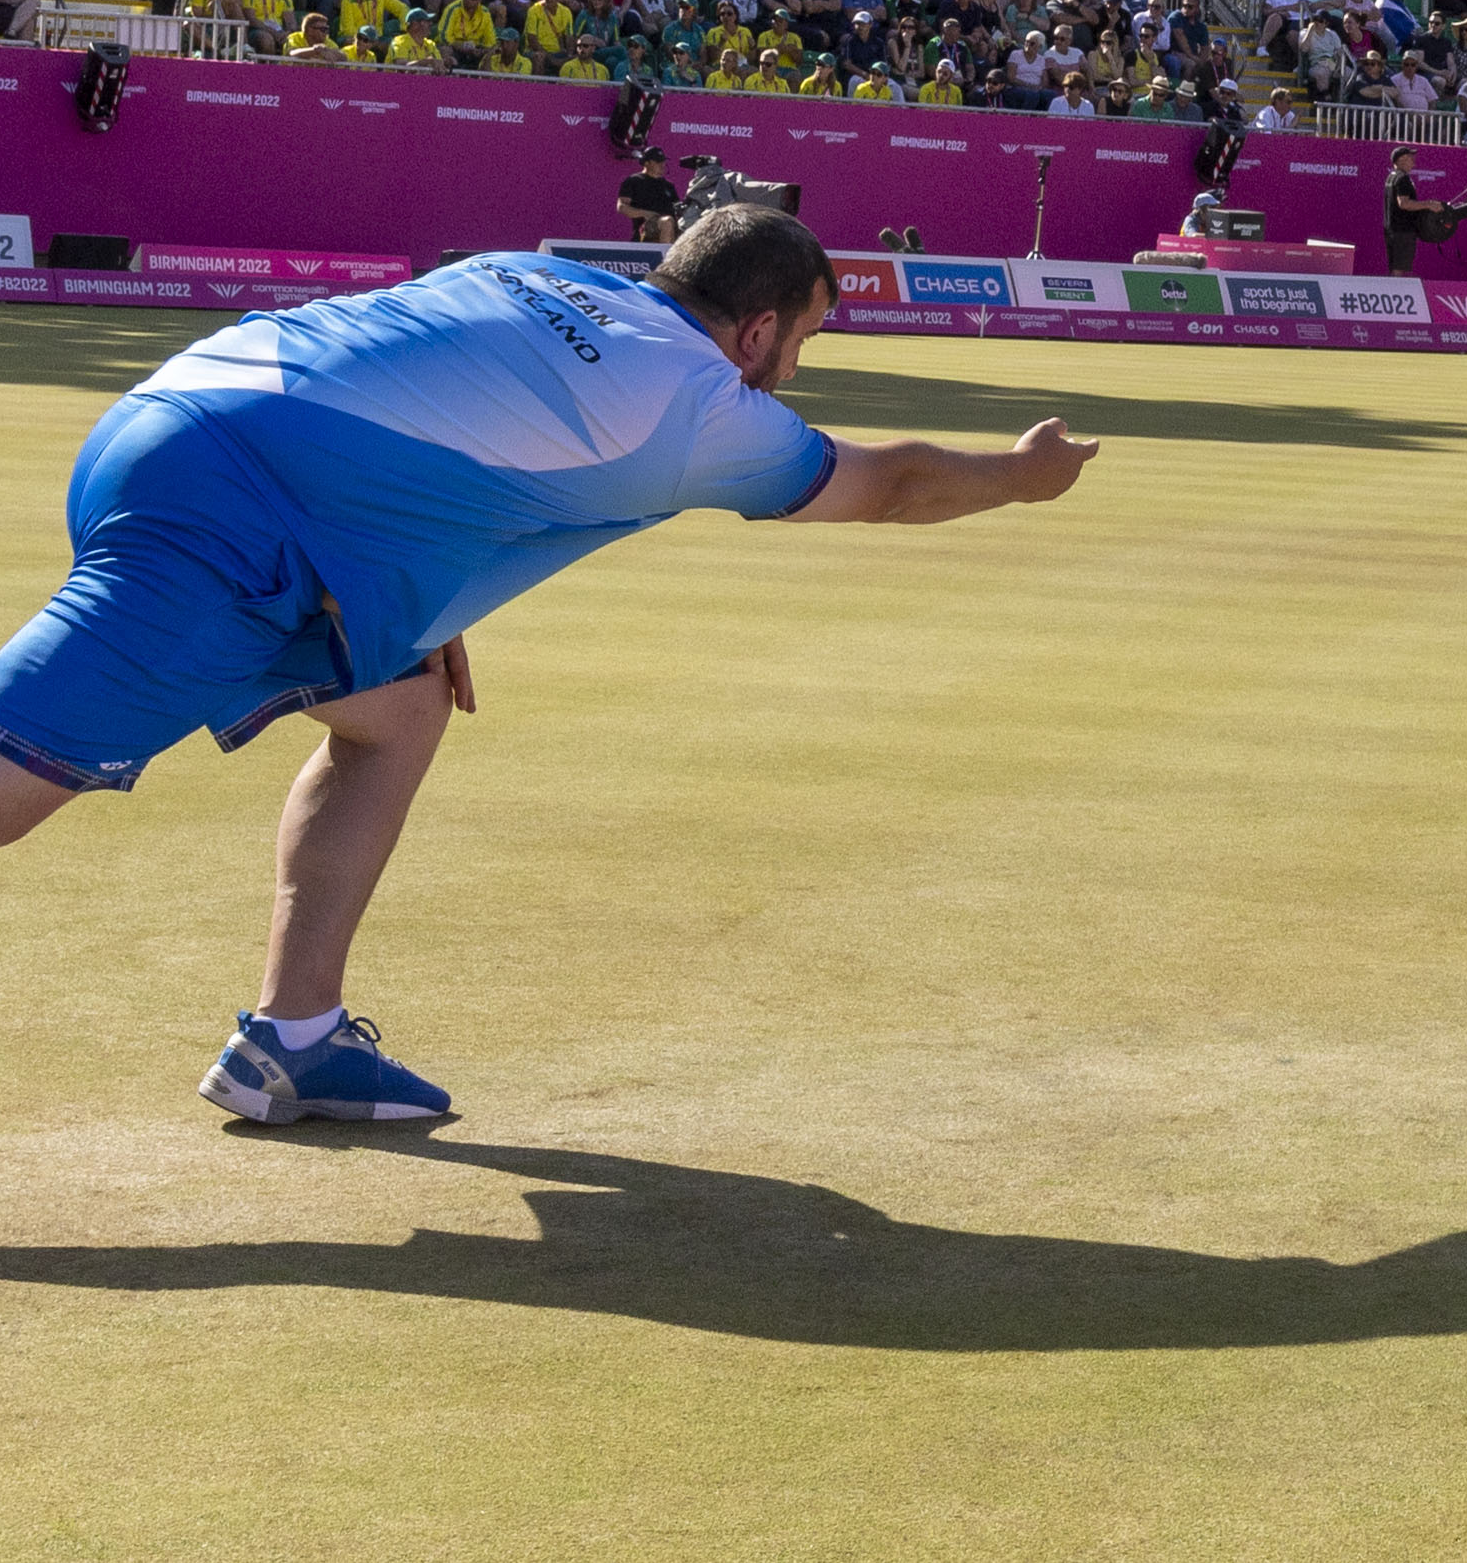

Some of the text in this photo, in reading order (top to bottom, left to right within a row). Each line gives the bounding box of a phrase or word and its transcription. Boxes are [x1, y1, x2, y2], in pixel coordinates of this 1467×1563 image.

[186, 89, 280, 108] BIRMINGHAM 2022
[436, 106, 524, 124] BIRMINGHAM 2022
[670, 121, 753, 138] BIRMINGHAM 2022
[890, 135, 967, 152] BIRMINGHAM 2022
[1096, 148, 1169, 165] BIRMINGHAM 2022
[1289, 161, 1358, 176] BIRMINGHAM 2022
[149, 254, 271, 274] BIRMINGHAM 2022
[330, 261, 404, 273] commonwealth
[350, 269, 385, 279] games
[64, 278, 192, 298] BIRMINGHAM 2022
[252, 283, 329, 295] commonwealth
[914, 276, 981, 295] CHASE
[1047, 279, 1088, 288] SEVERN
[274, 292, 309, 302] games
[1054, 291, 1086, 299] TRENT
[1161, 289, 1187, 299] Dettol
[1243, 286, 1308, 301] sport is just
[1240, 297, 1316, 314] the beginning
[1339, 292, 1418, 316] #B2022
[849, 308, 923, 324] BIRMINGHAM
[924, 311, 952, 325] 2022
[1234, 325, 1268, 335] CHASE
